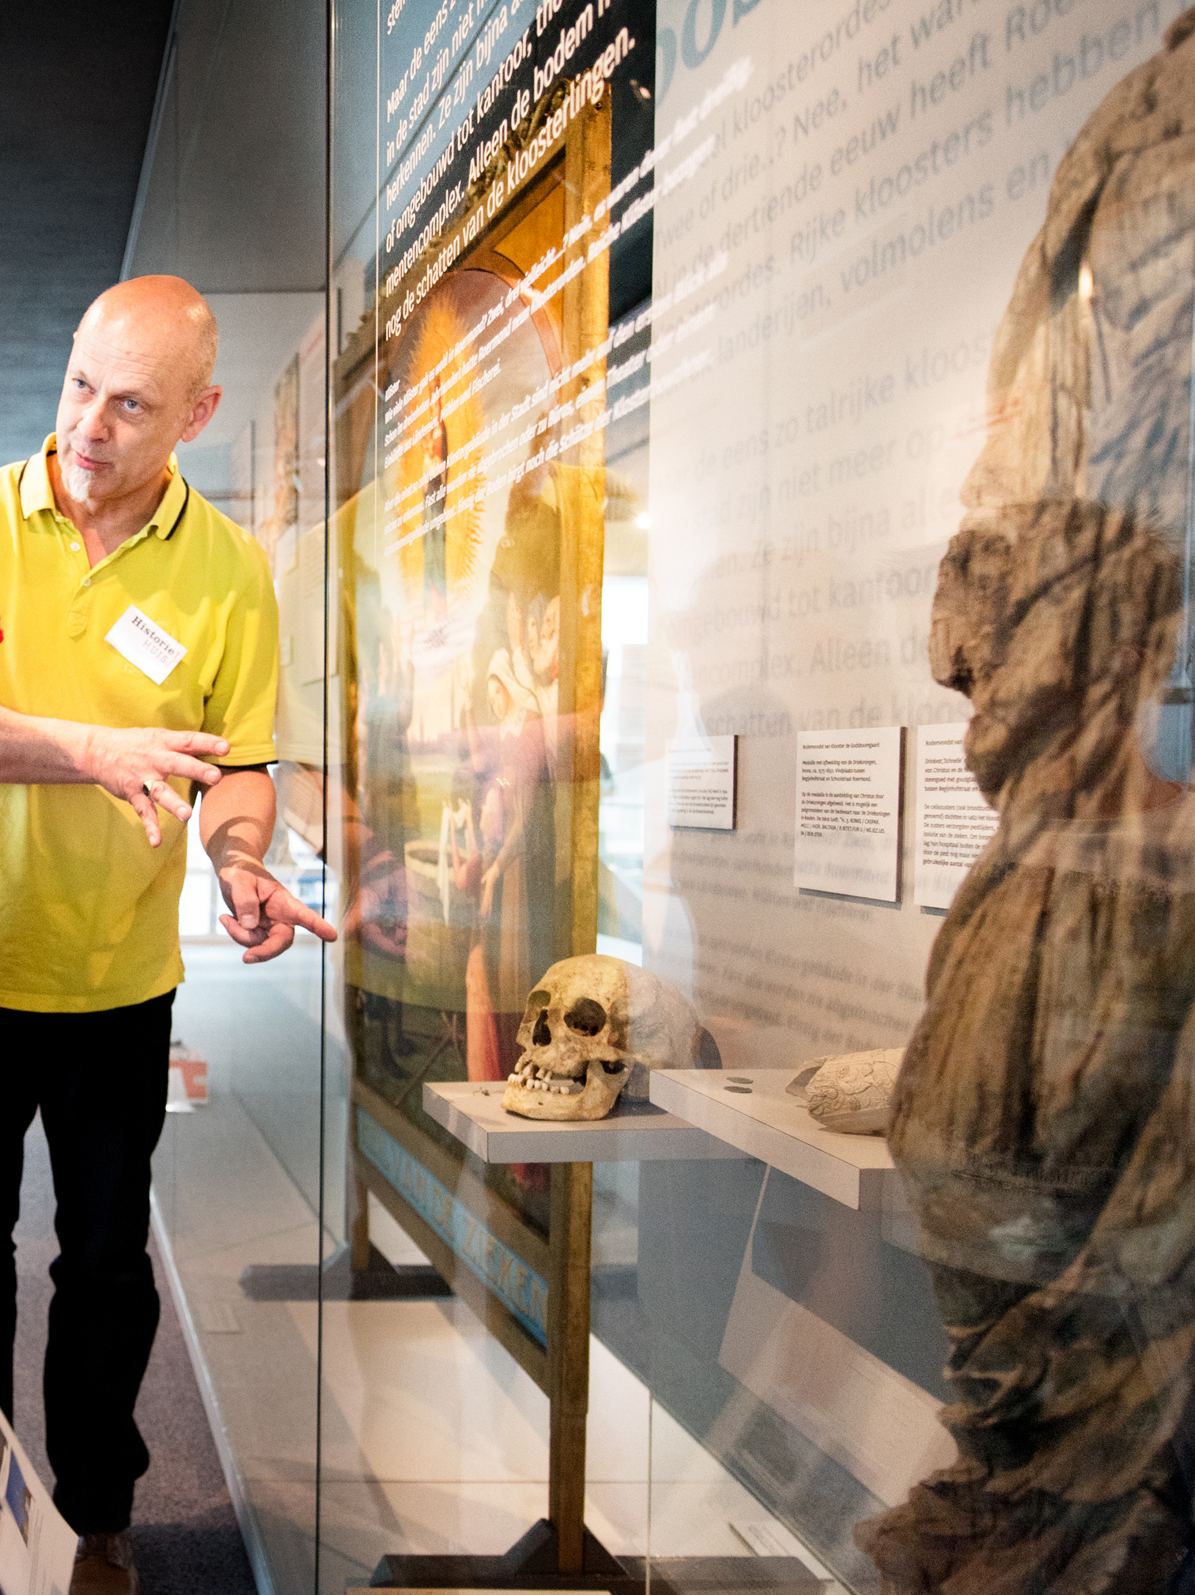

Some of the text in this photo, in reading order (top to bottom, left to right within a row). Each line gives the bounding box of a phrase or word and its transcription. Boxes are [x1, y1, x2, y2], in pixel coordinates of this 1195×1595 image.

[386, 0, 448, 123] Maar de eens
[386, 2, 474, 167] in de stad zijn niet
[386, 5, 507, 210] herkennen. Ze zijn bijna
[830, 101, 899, 180] eeuw
[910, 30, 988, 119] heeft
[856, 32, 901, 95] het
[385, 3, 593, 297] mentencomplex. Alleen de bodem
[385, 27, 635, 341] nog de schatten van de kloosterlingen.
[386, 219, 396, 253] of
[396, 130, 454, 238] omgebouwd
[457, 108, 473, 151] tot
[476, 18, 532, 123] kantoor,
[789, 209, 844, 266] Rijke
[854, 109, 992, 224] kloosters
[1005, 2, 1160, 128] hebben
[841, 182, 993, 295] volmolens
[1006, 151, 1050, 204] en
[510, 395, 530, 423] Stadt
[775, 420, 798, 450] zo
[806, 376, 894, 435] talrijke
[778, 468, 819, 505] niet
[829, 441, 894, 487] meer
[827, 507, 891, 552] bijna
[131, 615, 175, 655] Historie
[142, 640, 169, 664] HUIS
[809, 643, 889, 676] Alleen
